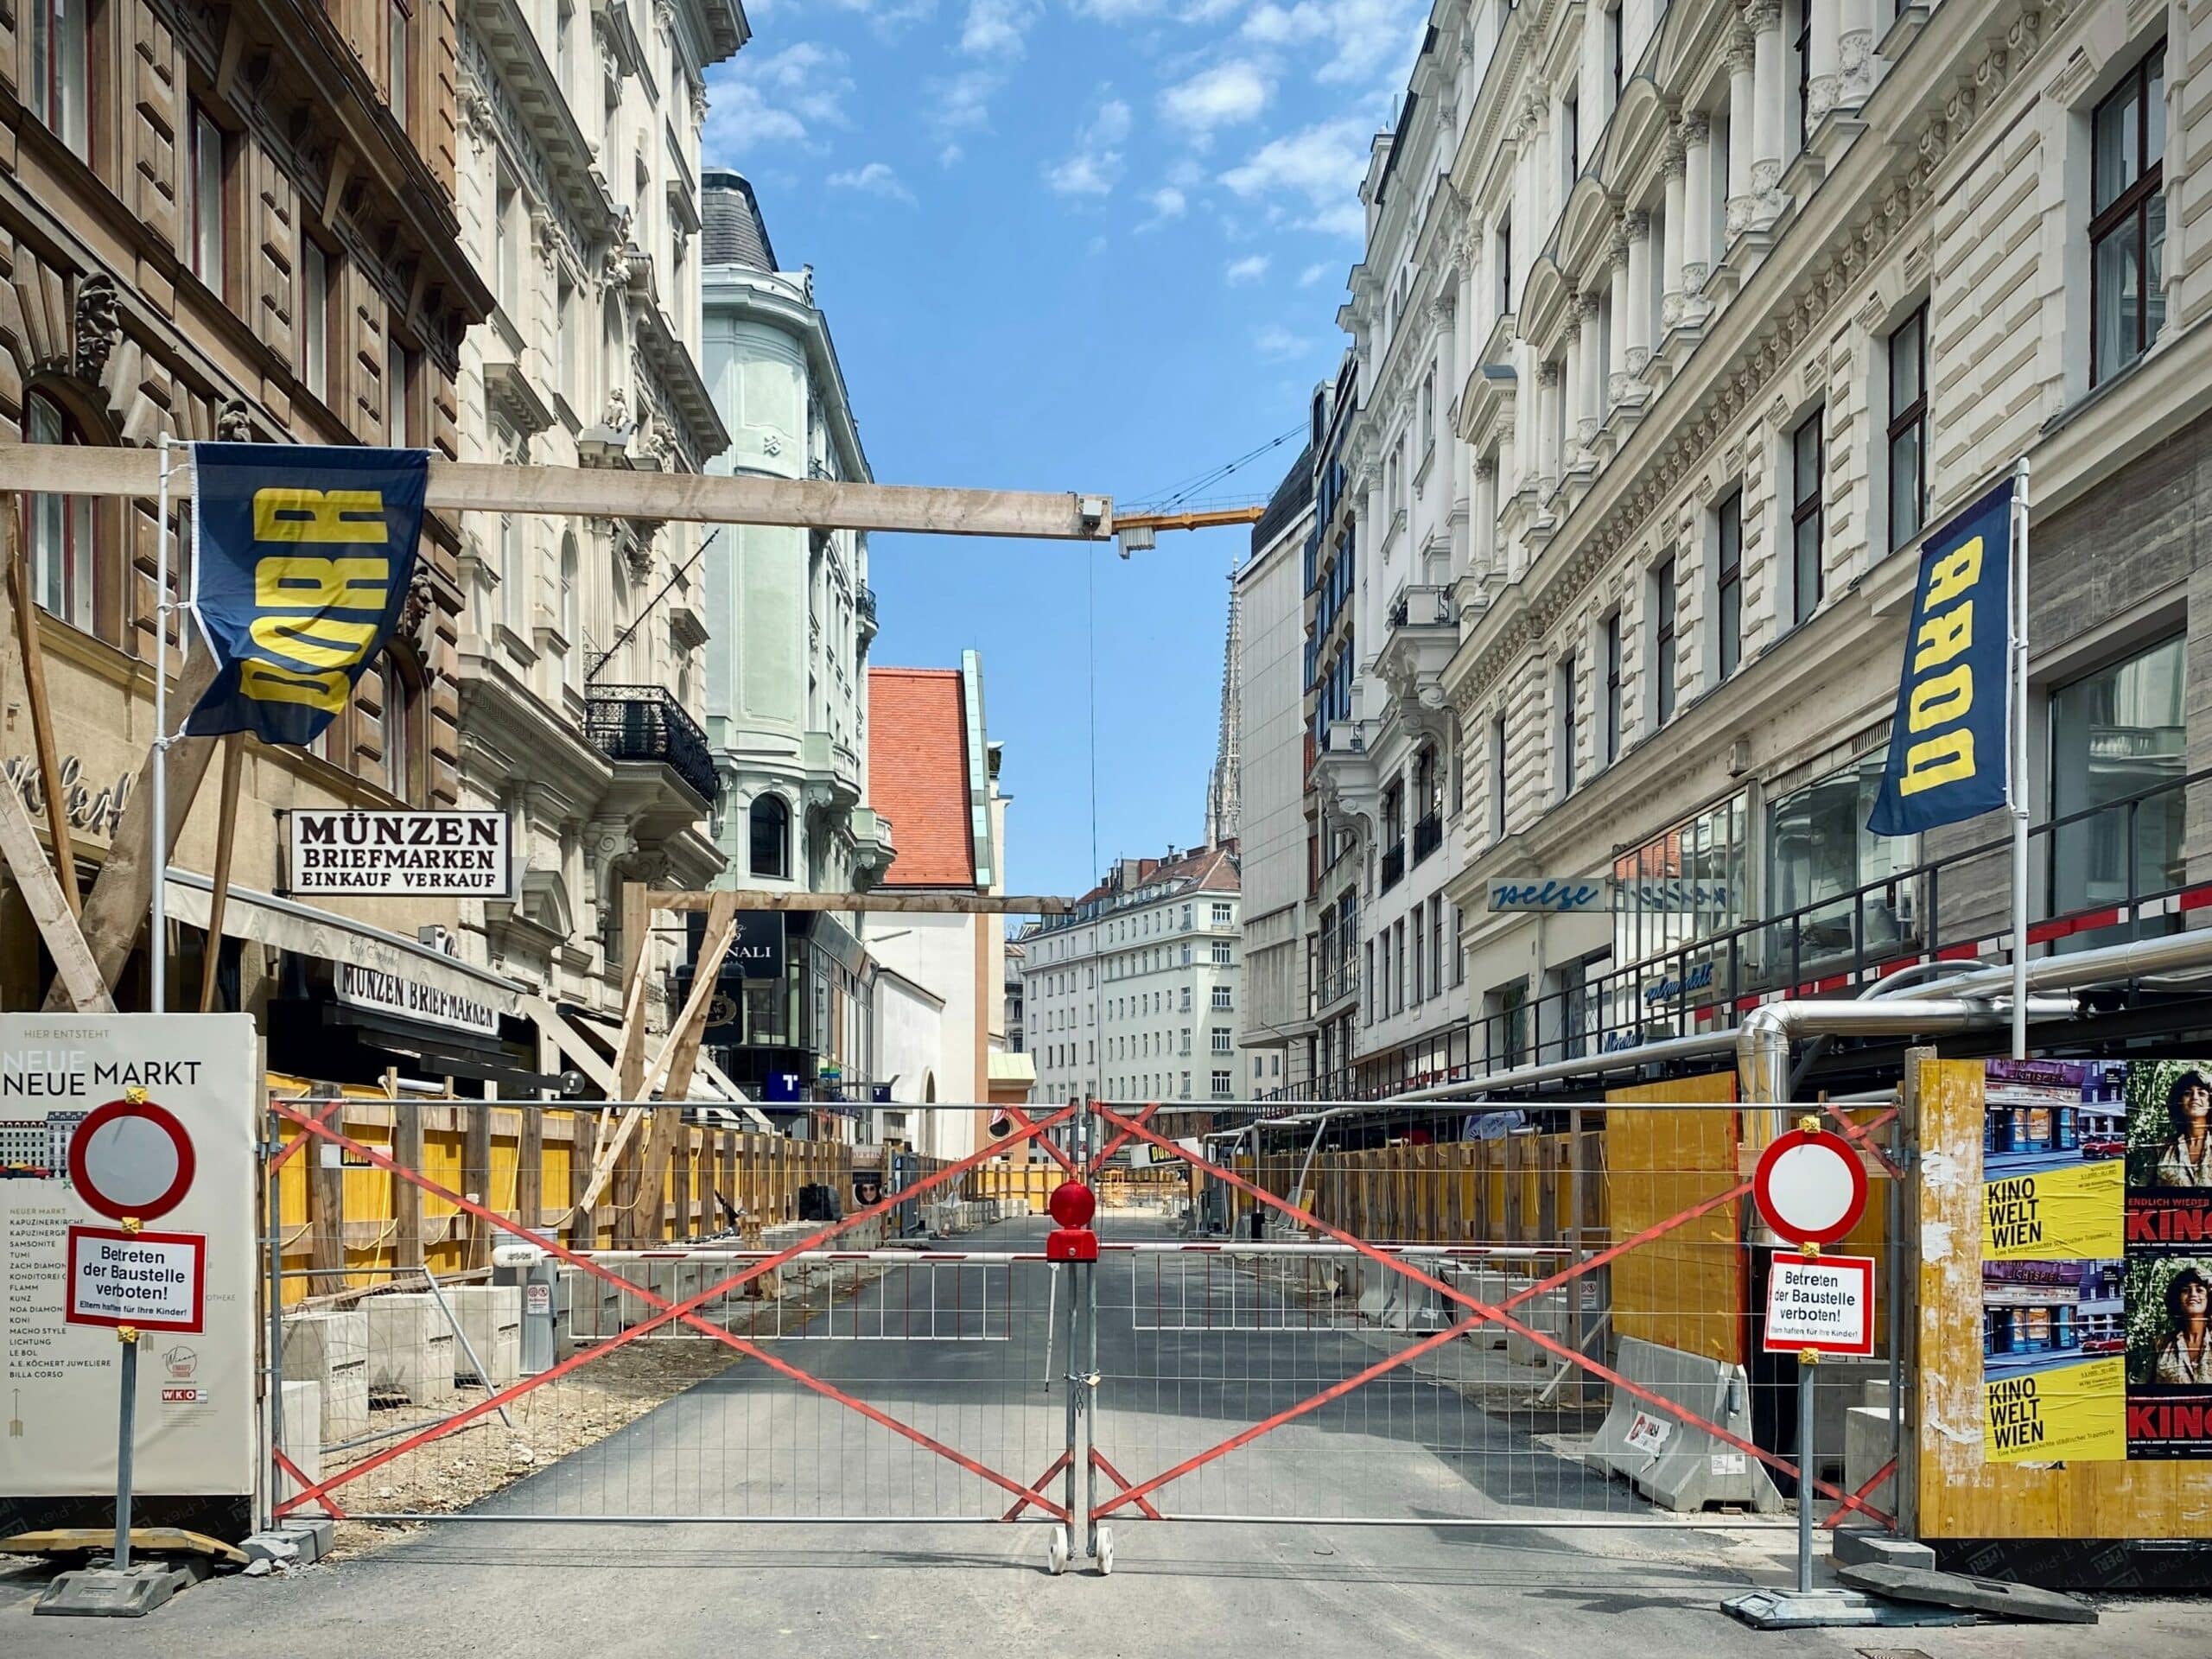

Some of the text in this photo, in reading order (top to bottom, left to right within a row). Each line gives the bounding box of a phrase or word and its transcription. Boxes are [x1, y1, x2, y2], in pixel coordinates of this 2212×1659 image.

[300, 813, 498, 845] MÜNZEN
[303, 849, 494, 869] BRIEFMARKEN
[302, 872, 496, 887] EINKAUF VERKAUF
[1492, 880, 1599, 910] pelze
[24, 1029, 111, 1039] HIER ENTSTEHT
[3, 1050, 86, 1073] NEUE
[94, 1061, 201, 1085] MARKT
[3, 1072, 86, 1096] NEUE
[1988, 1178, 2035, 1205] KINO
[2128, 1198, 2209, 1207] ENDLICH WIEDER
[1989, 1198, 2039, 1227] WELT
[1992, 1221, 2042, 1249] WIEN
[2128, 1209, 2212, 1241] KIN
[101, 1246, 164, 1264] Betreten
[83, 1262, 107, 1277] der
[111, 1265, 186, 1283] Baustelle
[1785, 1271, 1838, 1287] Betreten
[96, 1283, 168, 1300] verboten!
[1775, 1288, 1855, 1306] der Baustelle
[137, 1306, 154, 1314] Ihre
[156, 1307, 188, 1316] Kinder!
[1780, 1307, 1840, 1322] verboten!
[162, 1390, 195, 1399] WKO
[1989, 1377, 2036, 1406] KINO
[1990, 1398, 2040, 1427] WELT
[2128, 1406, 2212, 1438] KIN
[1994, 1421, 2044, 1449] WIEN
